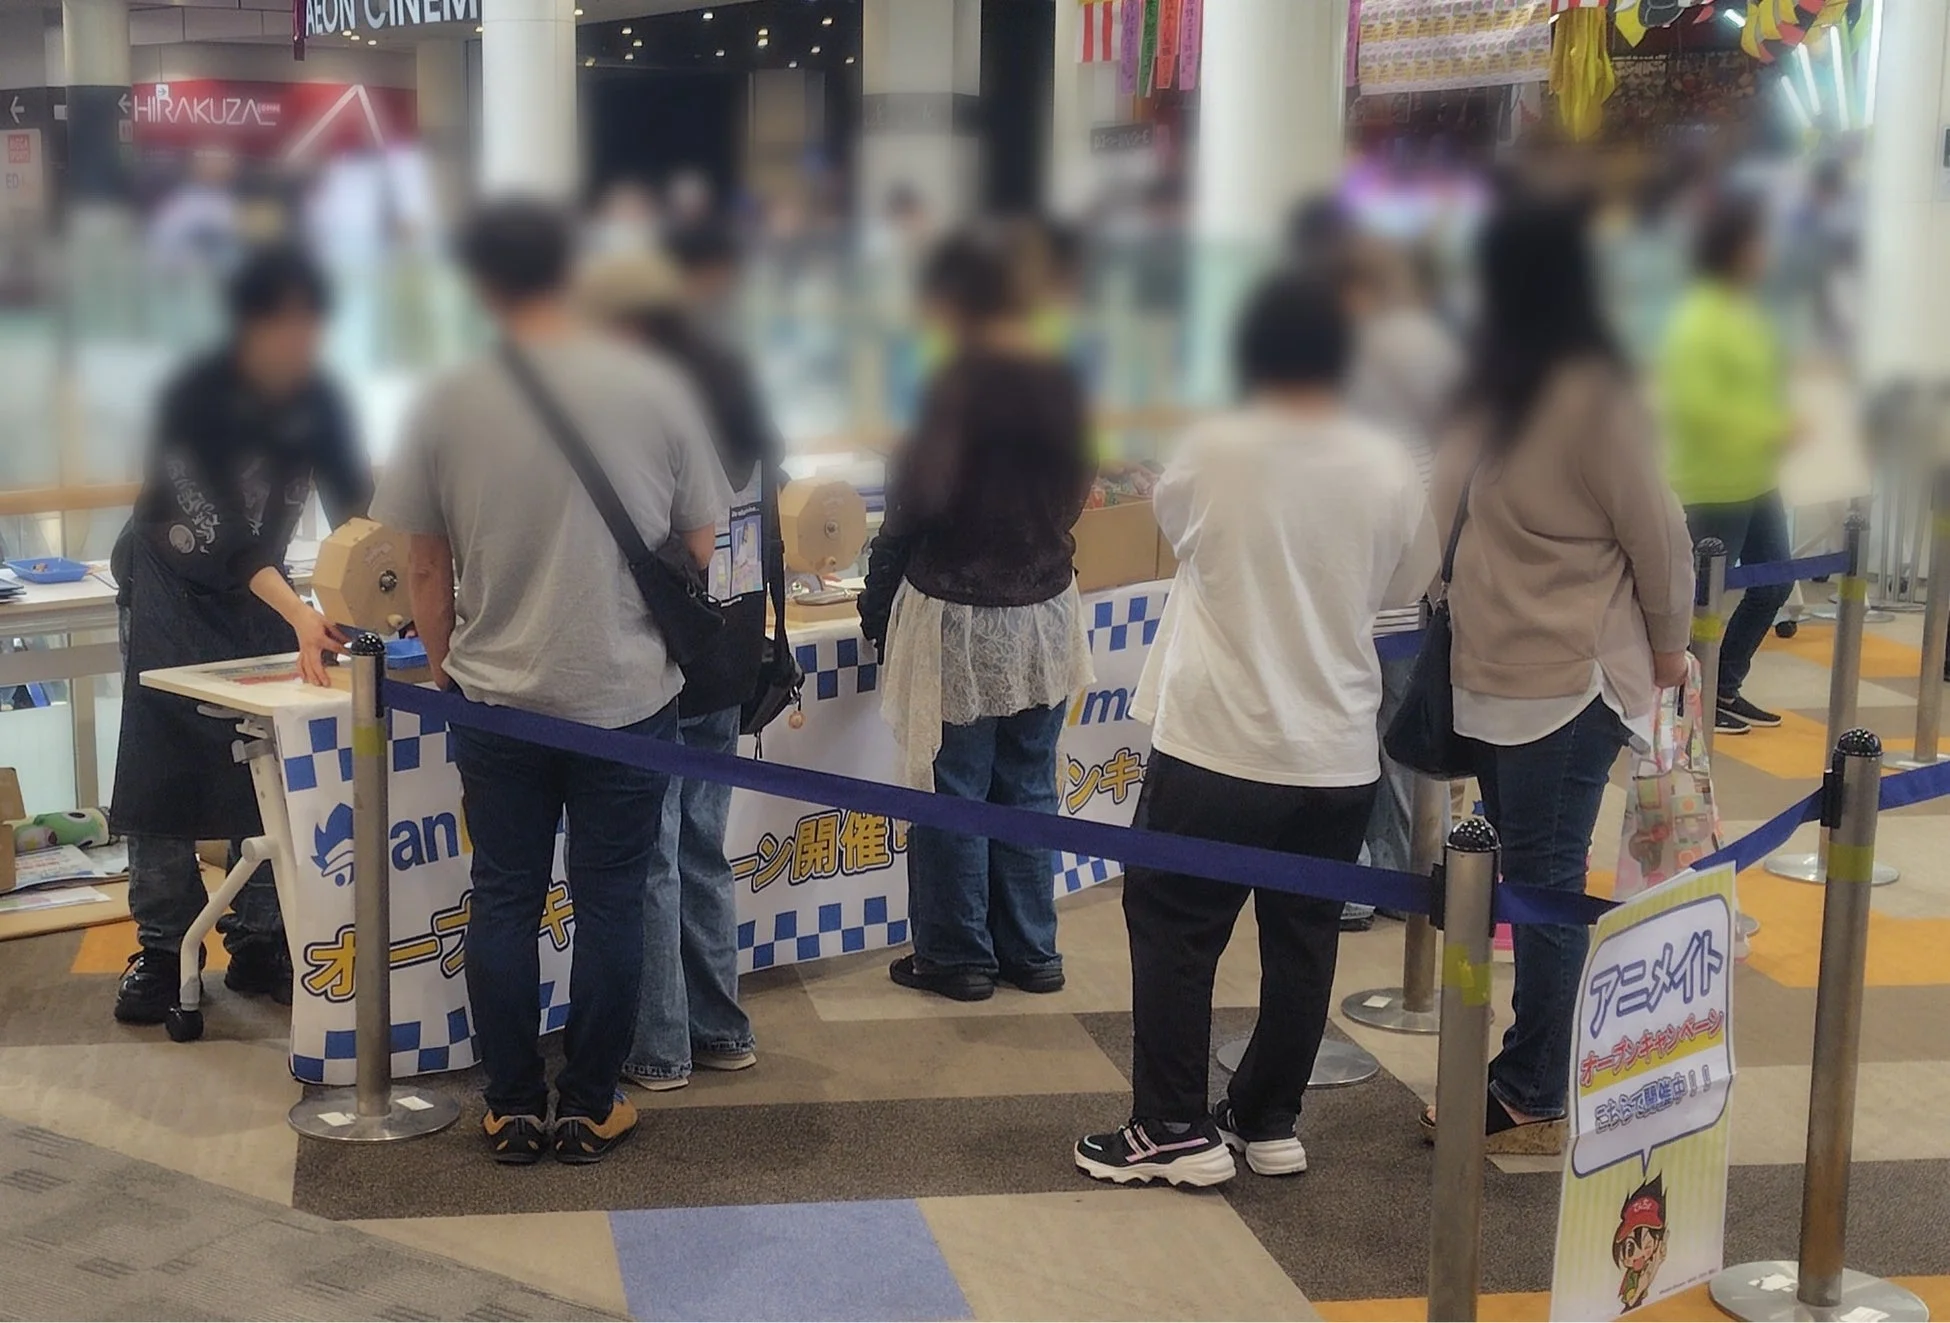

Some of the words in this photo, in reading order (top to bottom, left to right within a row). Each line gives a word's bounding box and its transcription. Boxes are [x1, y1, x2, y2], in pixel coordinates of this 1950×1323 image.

[306, 0, 356, 36] AEON
[134, 95, 277, 126] HIRAKUZA
[1590, 929, 1724, 1040] アニメイト
[1580, 1007, 1725, 1088] オープンキャンペーン
